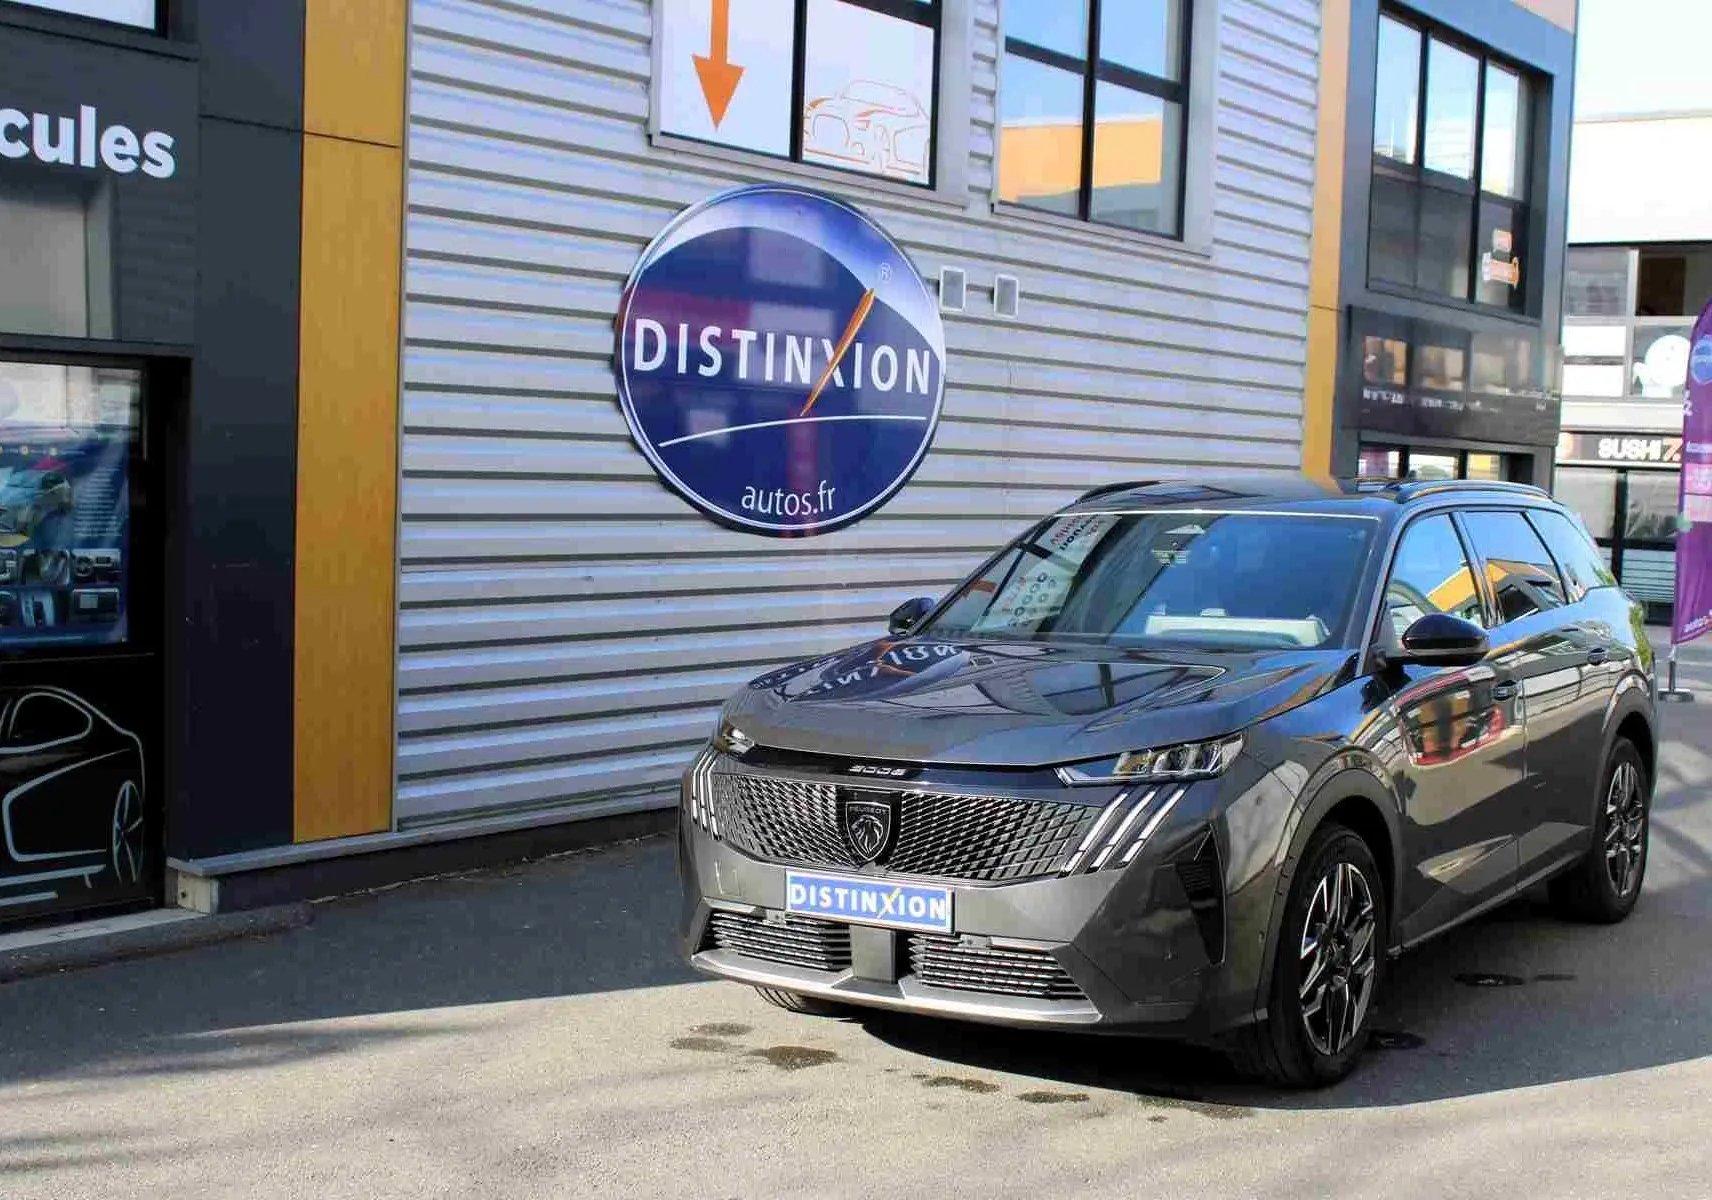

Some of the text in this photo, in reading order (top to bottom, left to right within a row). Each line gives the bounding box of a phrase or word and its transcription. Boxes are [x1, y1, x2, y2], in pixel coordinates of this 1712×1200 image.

[0, 104, 176, 179] cules
[633, 317, 931, 396] DISTINXION
[1598, 437, 1661, 461] SUSHI
[741, 479, 836, 517] autos.fr
[789, 883, 948, 920] DISTINXION
